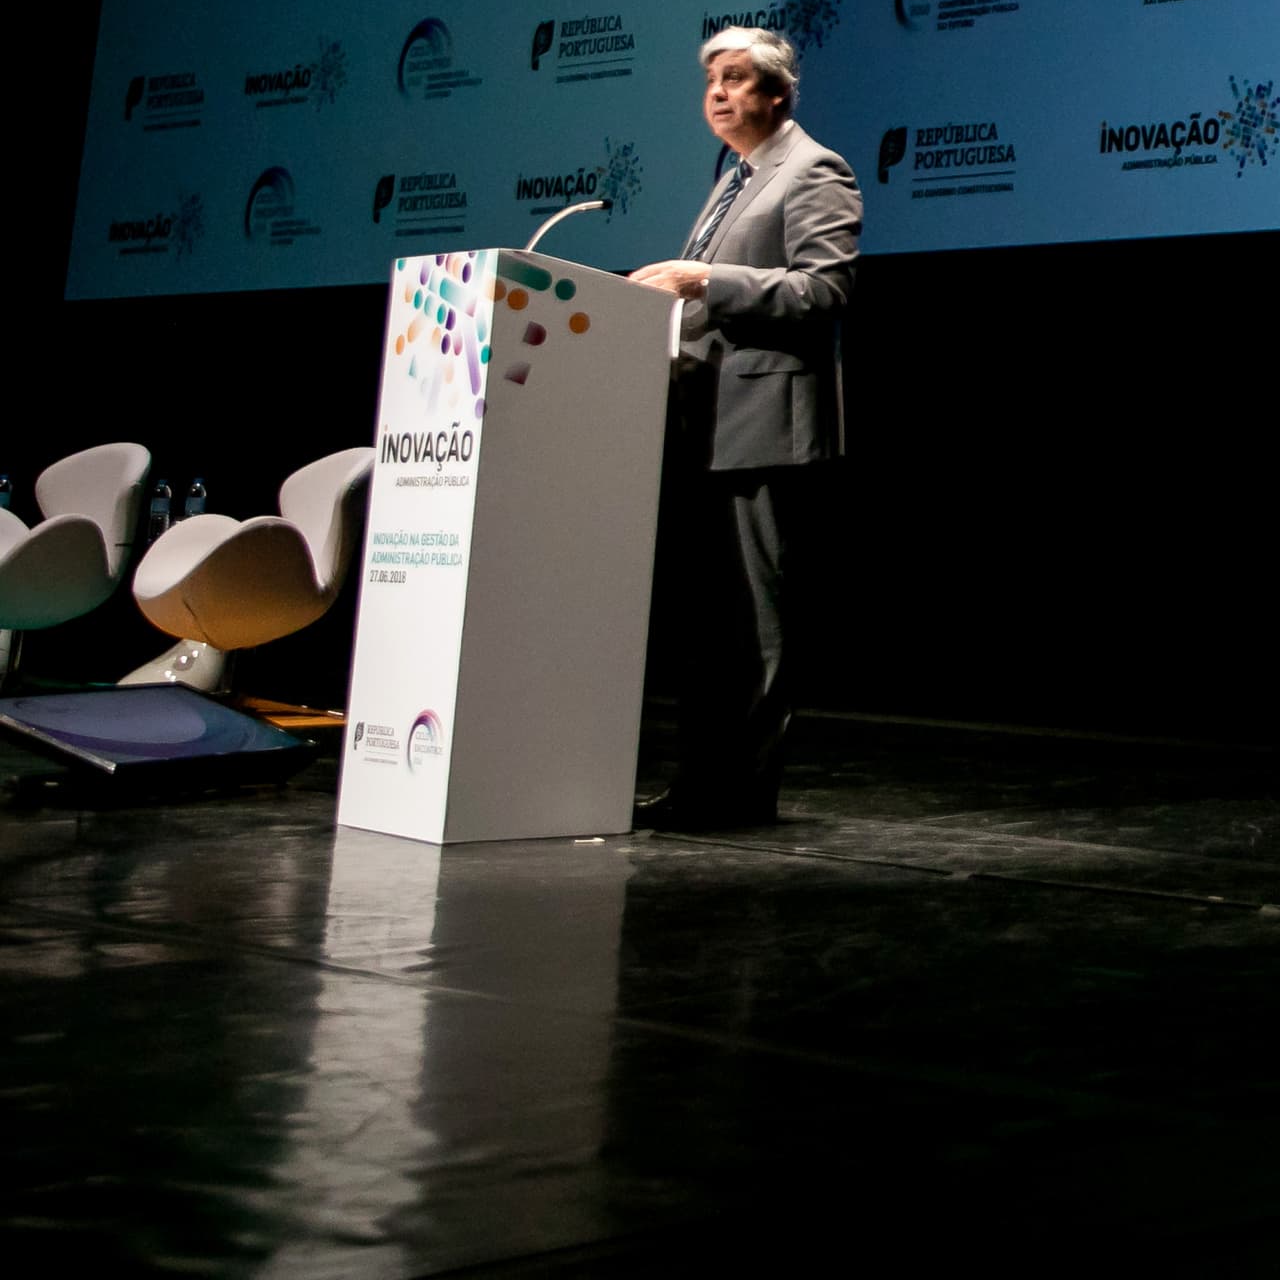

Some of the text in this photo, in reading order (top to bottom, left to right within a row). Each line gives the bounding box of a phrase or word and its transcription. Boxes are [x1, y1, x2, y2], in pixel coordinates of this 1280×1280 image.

[560, 15, 622, 38] REPÚBLICA
[558, 34, 635, 59] PORTUGUESA
[915, 122, 998, 147] REPÚBLICA
[914, 144, 1016, 171] PORTUGUESA
[421, 529, 448, 546] GESTÃO
[371, 549, 430, 568] ADMINISTRAÇÃO
